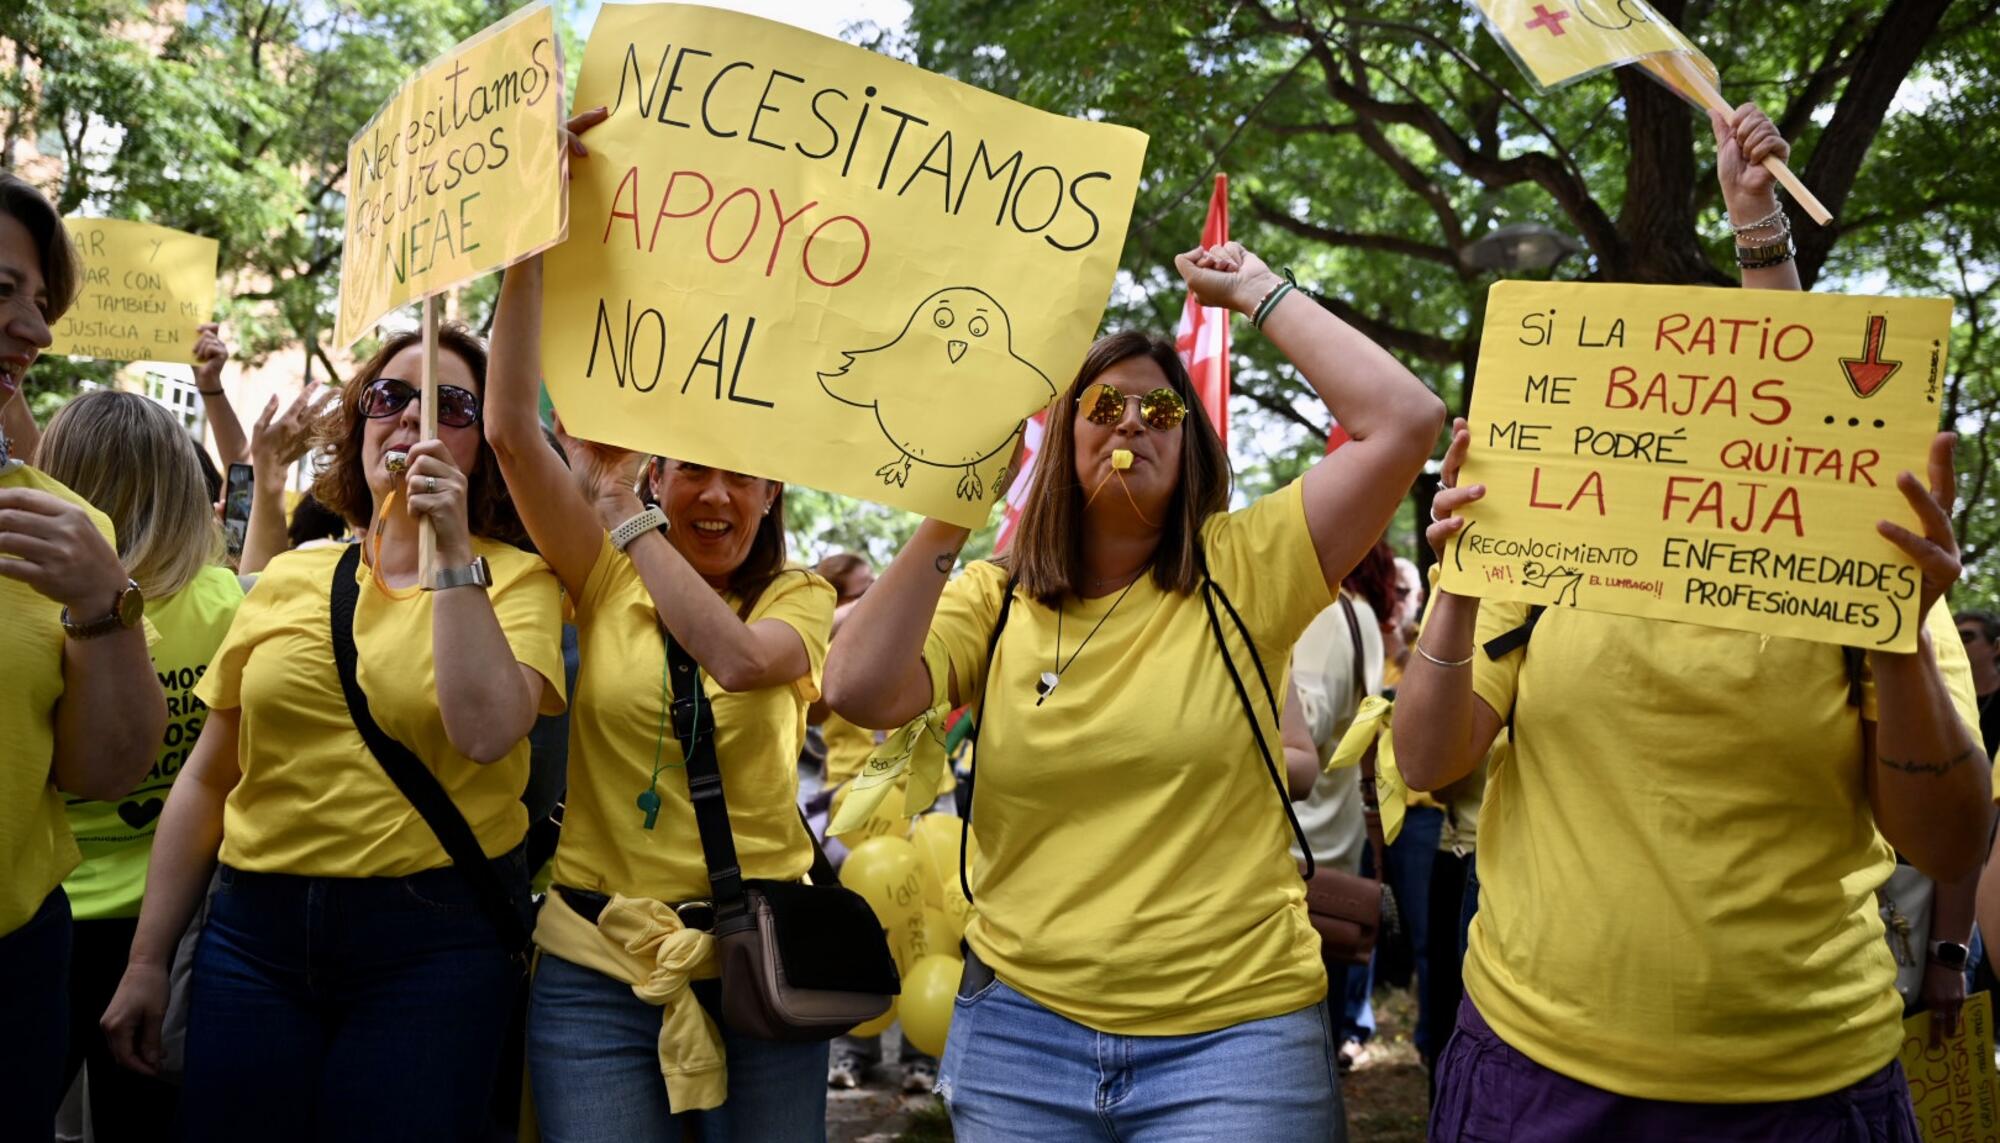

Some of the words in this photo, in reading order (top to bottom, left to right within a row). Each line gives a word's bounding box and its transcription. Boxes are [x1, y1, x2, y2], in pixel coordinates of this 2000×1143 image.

[385, 192, 481, 284] NEAE
[603, 166, 871, 287] APOYO
[74, 230, 105, 256] AR
[150, 239, 162, 263] Y
[123, 270, 161, 290] CON
[90, 293, 166, 314] TAMBIÉN
[60, 317, 138, 339] JUSTICIA
[155, 328, 179, 344] EN
[1577, 315, 1625, 348] LA
[586, 298, 666, 392] NO
[681, 313, 774, 408] AL
[1525, 374, 1577, 405] ME
[1604, 365, 1792, 425] BAJAS
[1489, 420, 1552, 452] ME
[1574, 428, 1688, 465] PODRÉ
[1528, 467, 1605, 515] LA
[1662, 476, 1805, 538] FAJA
[1662, 537, 1916, 600] ENFERMEDADES
[157, 664, 208, 691] MOS
[167, 690, 208, 717] RÍA
[163, 718, 200, 747] OS
